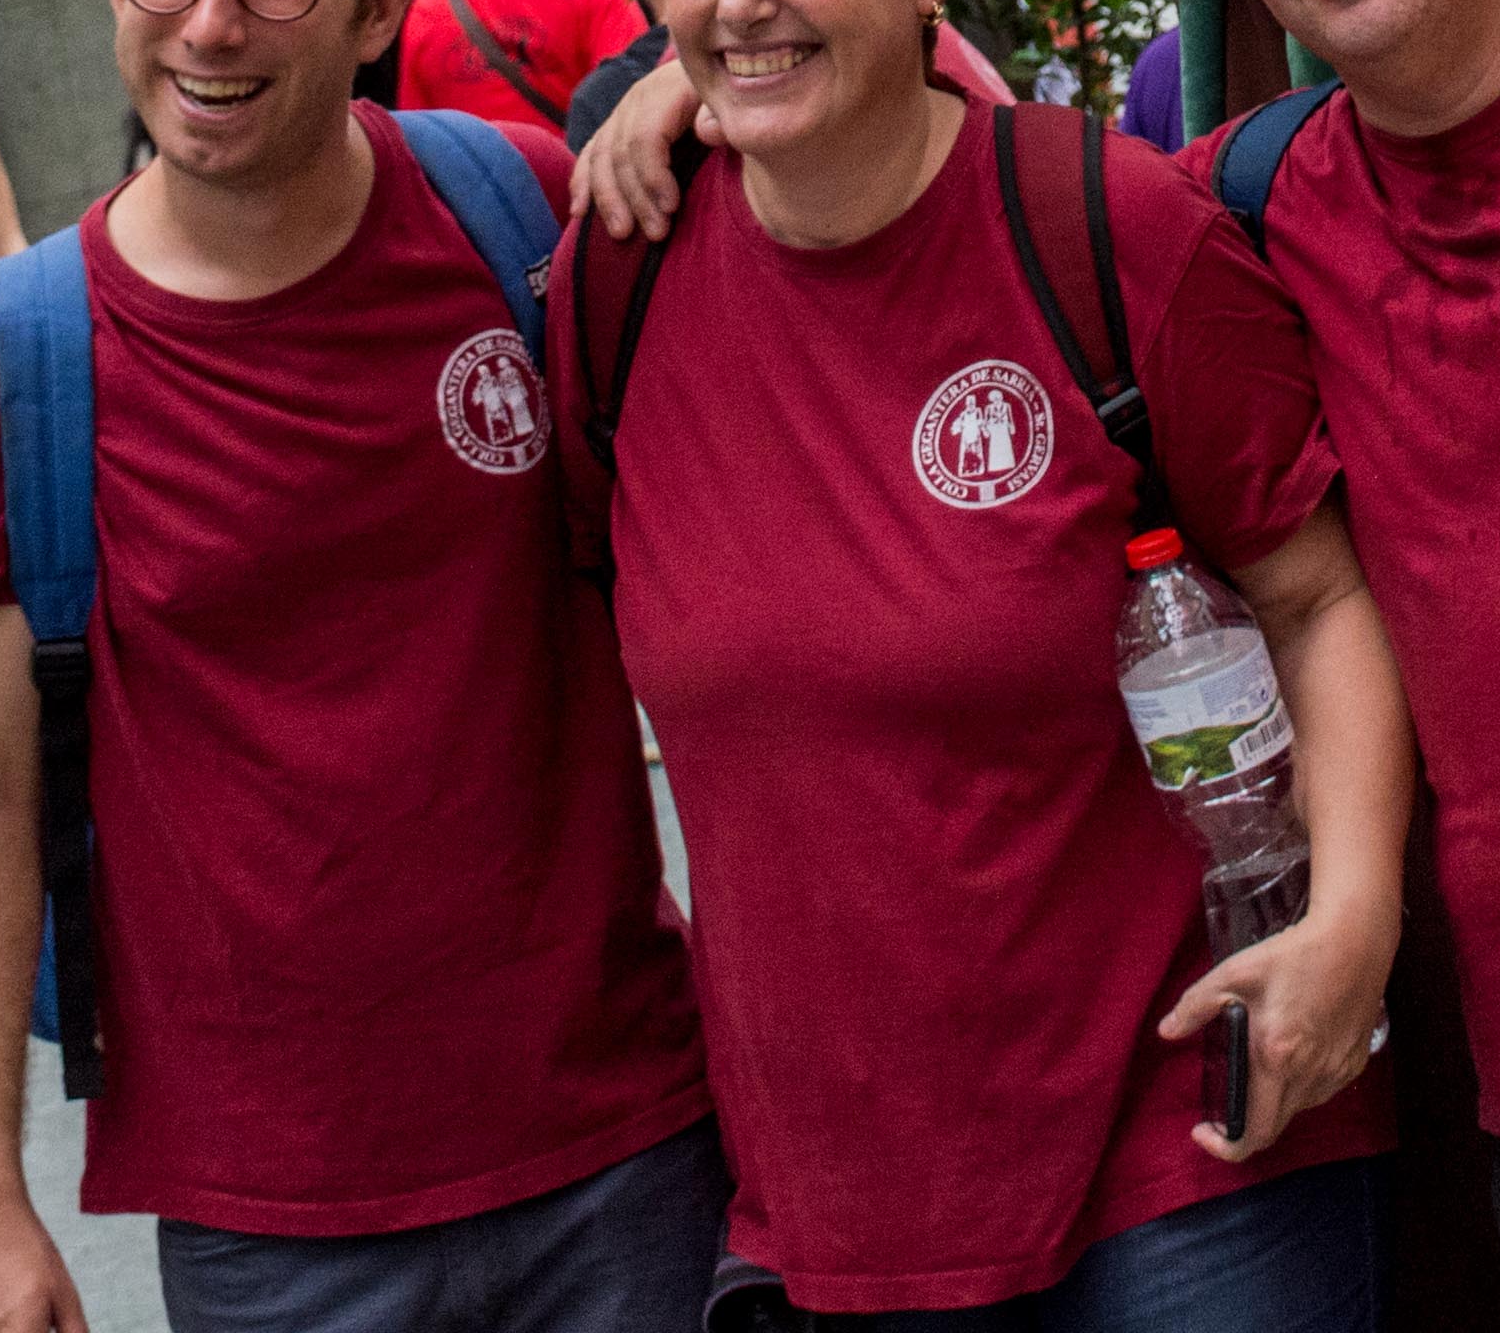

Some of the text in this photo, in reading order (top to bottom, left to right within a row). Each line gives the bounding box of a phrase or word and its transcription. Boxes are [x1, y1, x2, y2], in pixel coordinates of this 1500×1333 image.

[970, 368, 991, 384] DE
[921, 378, 969, 465] GEGANTERA
[928, 465, 969, 499] COLLA
